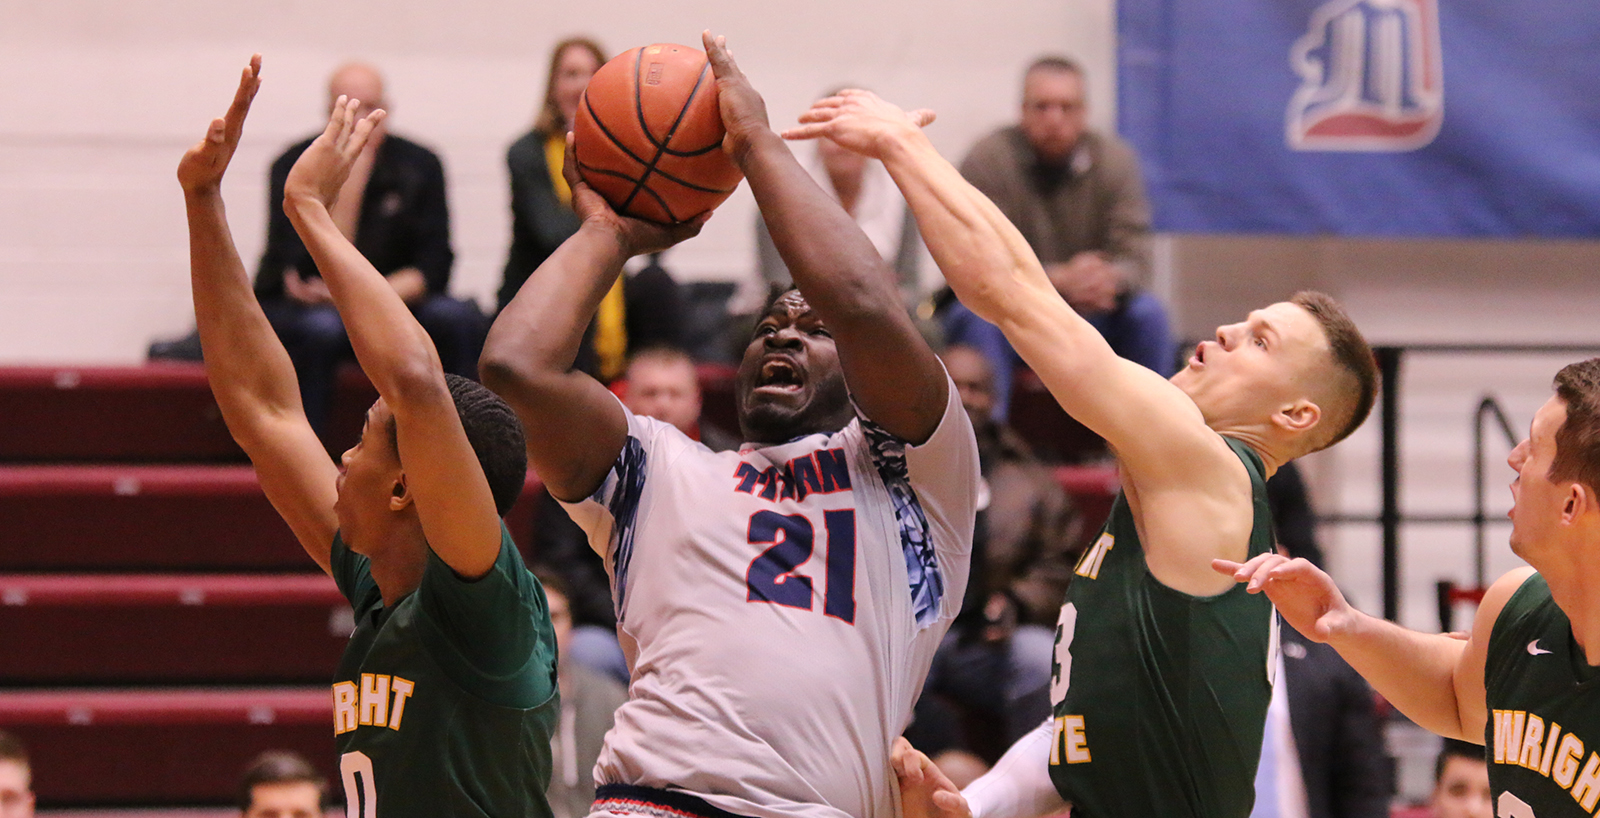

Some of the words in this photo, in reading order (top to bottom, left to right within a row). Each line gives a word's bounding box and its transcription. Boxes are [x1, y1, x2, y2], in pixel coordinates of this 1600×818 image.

[746, 508, 857, 626] 21
[1050, 715, 1092, 765] TE
[1492, 709, 1600, 818] WRIGH
